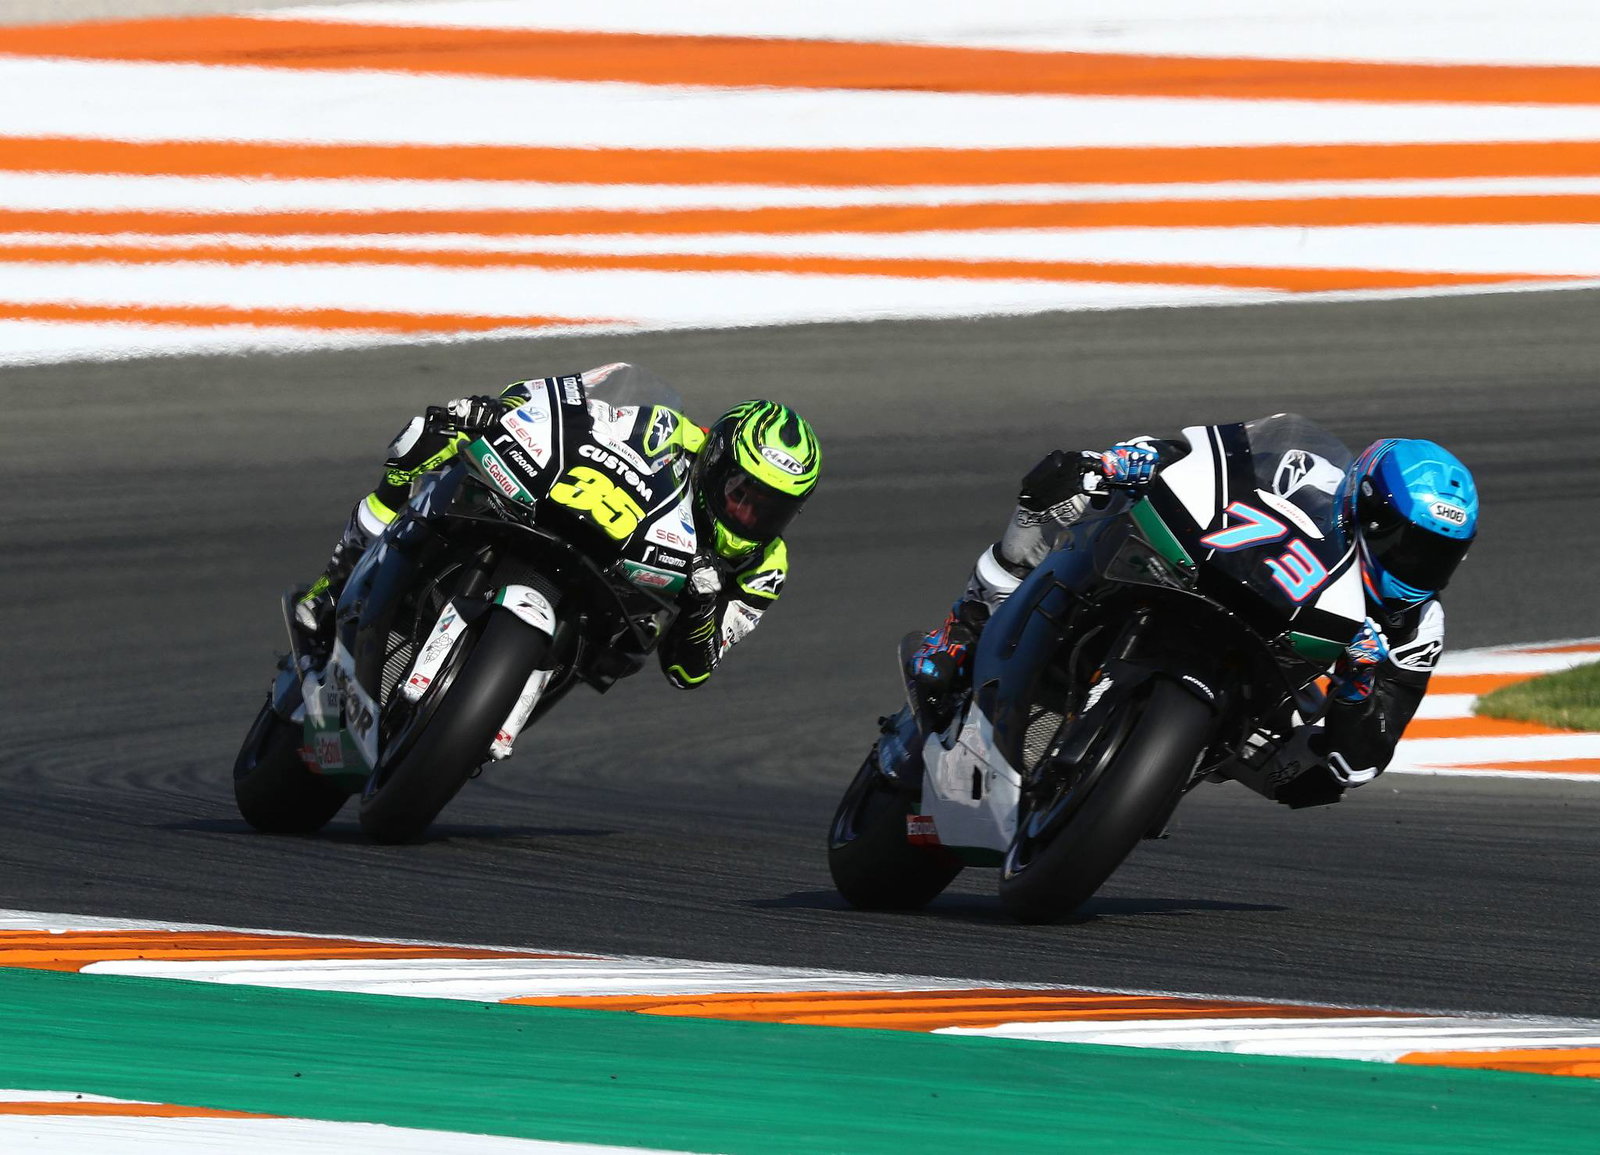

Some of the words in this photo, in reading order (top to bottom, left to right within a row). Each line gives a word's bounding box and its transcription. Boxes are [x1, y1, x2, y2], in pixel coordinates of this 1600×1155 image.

[507, 418, 543, 457] SENA
[489, 463, 517, 495] Castrol
[508, 449, 537, 477] rizoma
[578, 445, 653, 501] CUSTOM
[549, 466, 647, 540] 35
[656, 529, 694, 549] SENA
[1201, 501, 1330, 602] 73
